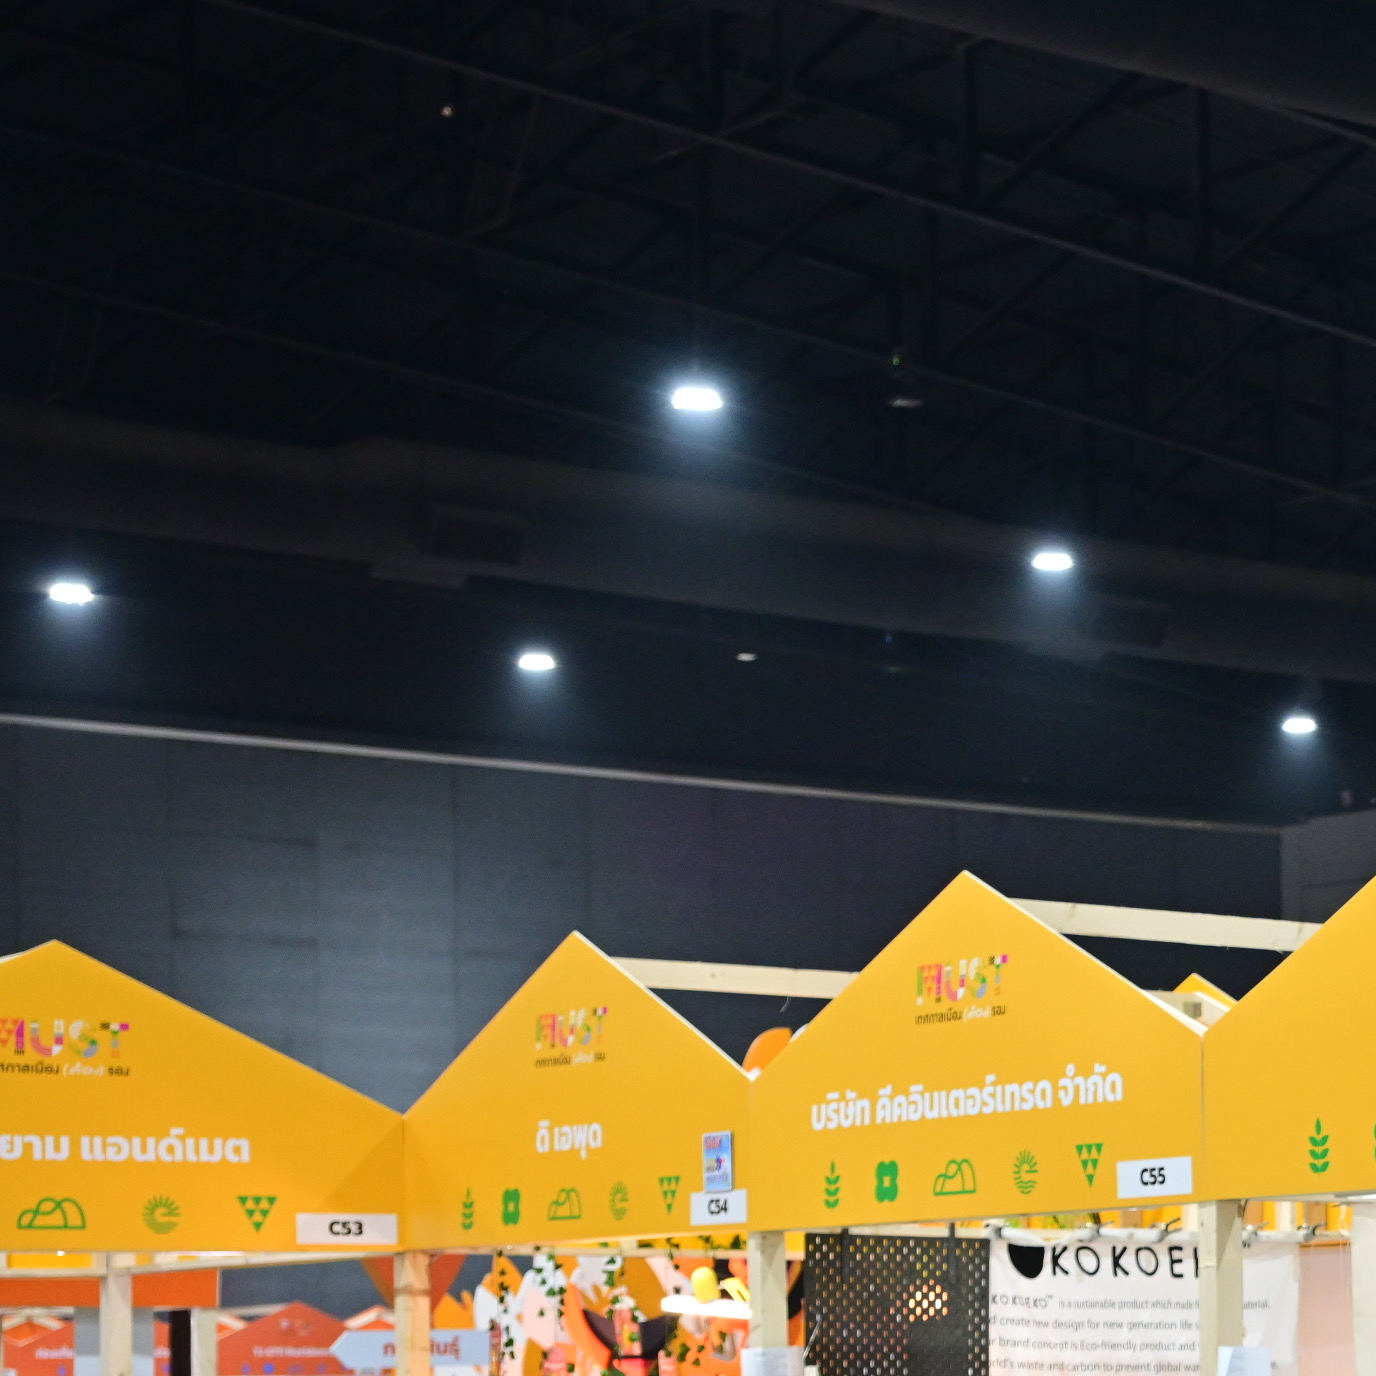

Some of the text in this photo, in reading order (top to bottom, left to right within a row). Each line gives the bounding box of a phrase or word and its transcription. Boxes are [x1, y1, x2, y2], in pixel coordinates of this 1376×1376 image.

[916, 954, 1008, 1006] MUST
[535, 1006, 608, 1051] MUST
[811, 1088, 870, 1131] บริษัท
[1057, 1062, 1123, 1106] จำกัด
[80, 1126, 251, 1163] แอนด์เมต
[1139, 1166, 1166, 1187] C55
[708, 1199, 728, 1215] C54
[328, 1220, 364, 1236] C53
[1051, 1245, 1199, 1279] KOKOE
[1118, 1300, 1148, 1311] product
[1150, 1300, 1172, 1309] which
[1052, 1319, 1084, 1331] design
[1087, 1319, 1100, 1329] for
[1103, 1321, 1123, 1330] new
[1127, 1320, 1176, 1332] generation
[1180, 1319, 1193, 1330] life
[1140, 1340, 1175, 1353] product
[1178, 1340, 1195, 1351] and
[1115, 1363, 1150, 1375] prevent
[1153, 1362, 1180, 1375] global
